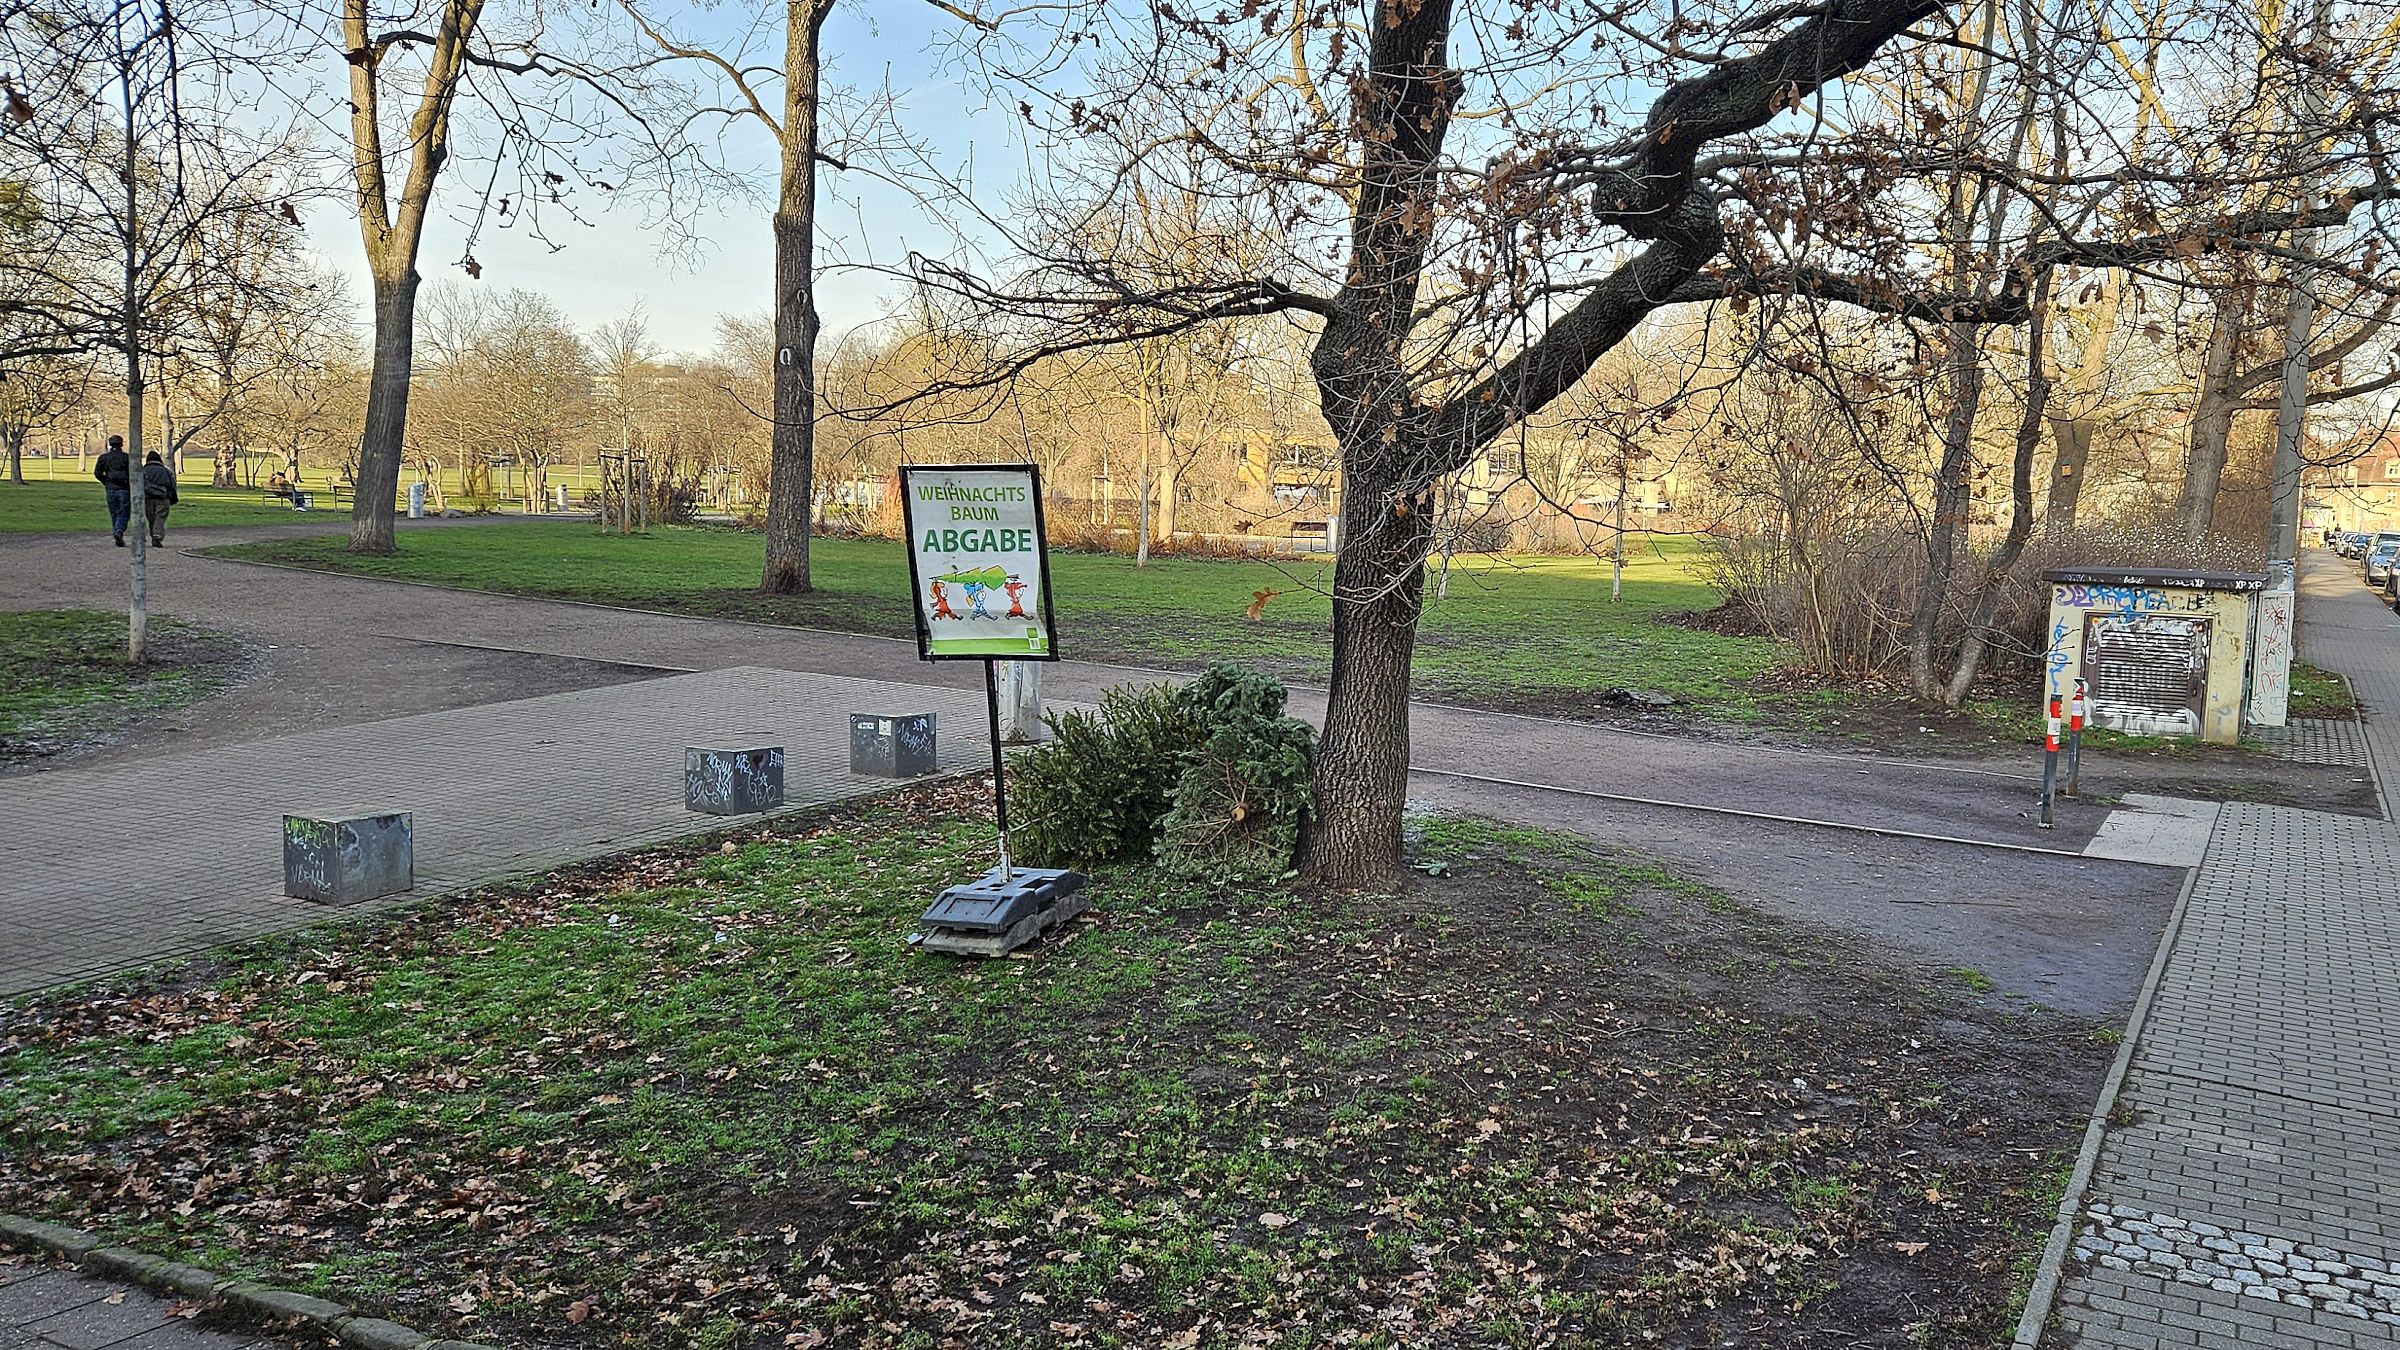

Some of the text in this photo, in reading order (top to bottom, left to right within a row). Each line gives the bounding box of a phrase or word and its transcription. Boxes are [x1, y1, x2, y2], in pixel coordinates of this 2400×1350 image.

[917, 486, 1026, 502] WEIHNACHTS
[951, 506, 1000, 521] BAUM
[922, 528, 1032, 553] ABGABE
[2248, 581, 2263, 590] XP
